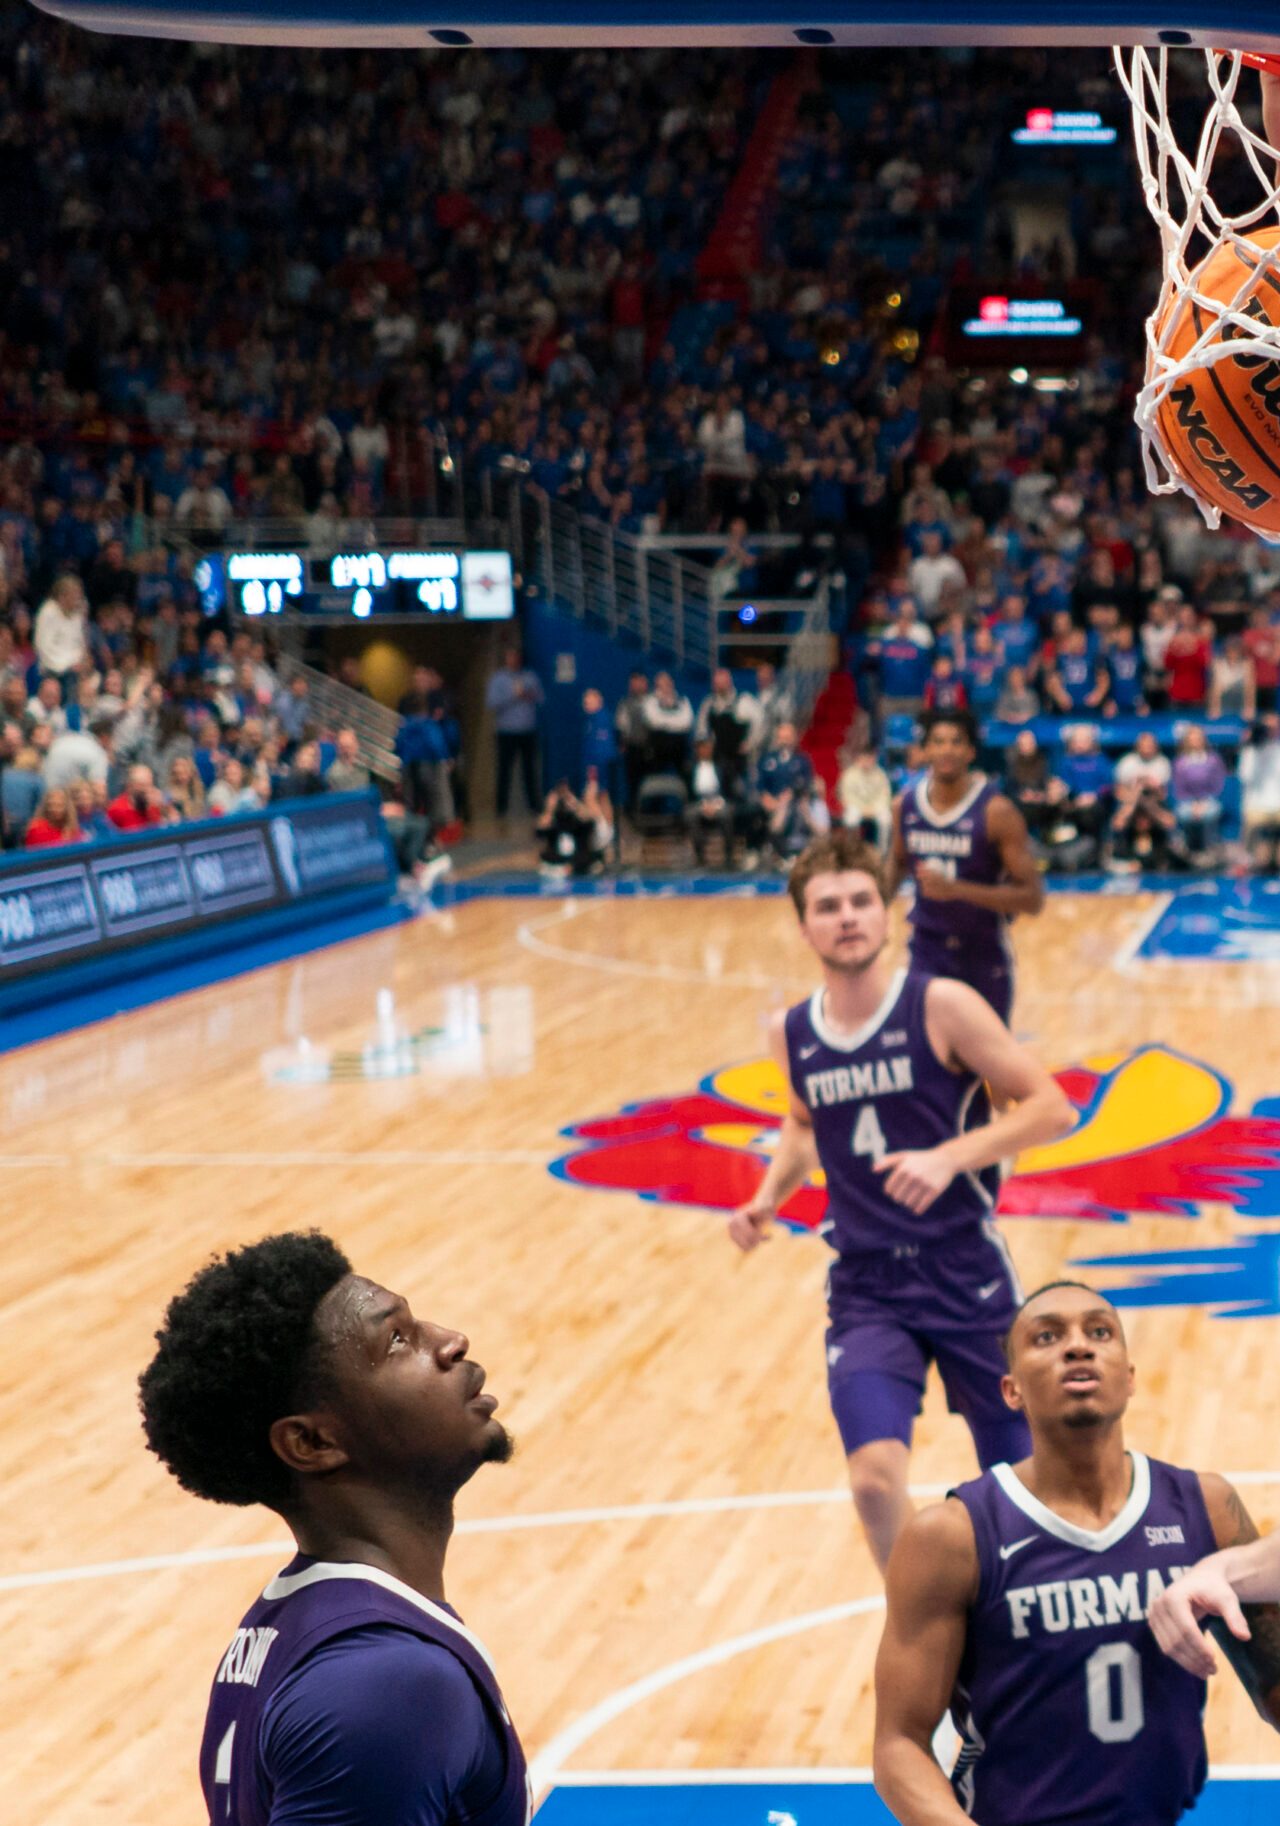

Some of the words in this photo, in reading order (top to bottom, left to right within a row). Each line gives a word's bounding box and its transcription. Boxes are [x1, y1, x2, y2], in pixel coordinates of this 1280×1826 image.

[1244, 393, 1265, 421] EVO
[1169, 384, 1273, 510] NCAA
[805, 1056, 913, 1109] FURMAN
[852, 1104, 887, 1170] 4
[1085, 1641, 1145, 1743] 0
